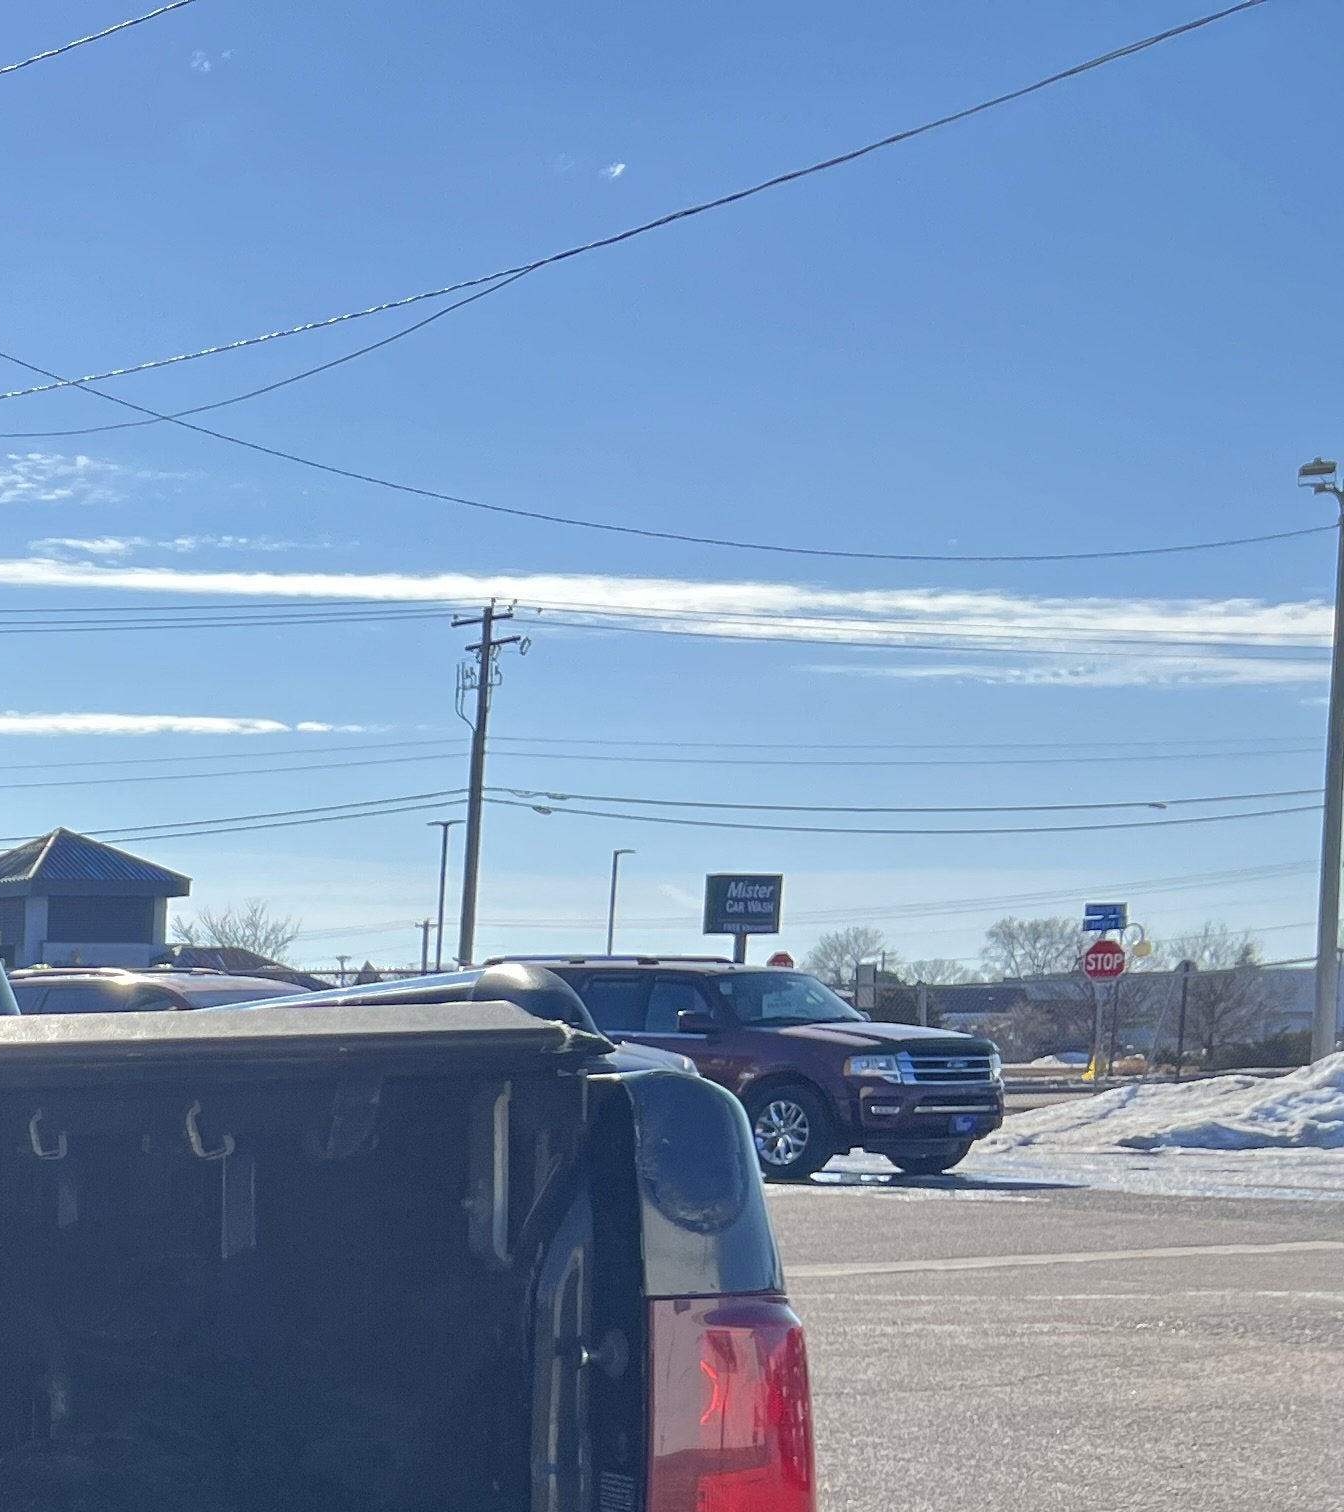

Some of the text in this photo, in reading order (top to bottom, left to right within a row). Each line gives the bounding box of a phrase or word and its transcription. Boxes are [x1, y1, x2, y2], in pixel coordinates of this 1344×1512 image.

[727, 881, 774, 898] Mister
[726, 900, 774, 913] CAR WASH
[1086, 953, 1123, 971] STOP
